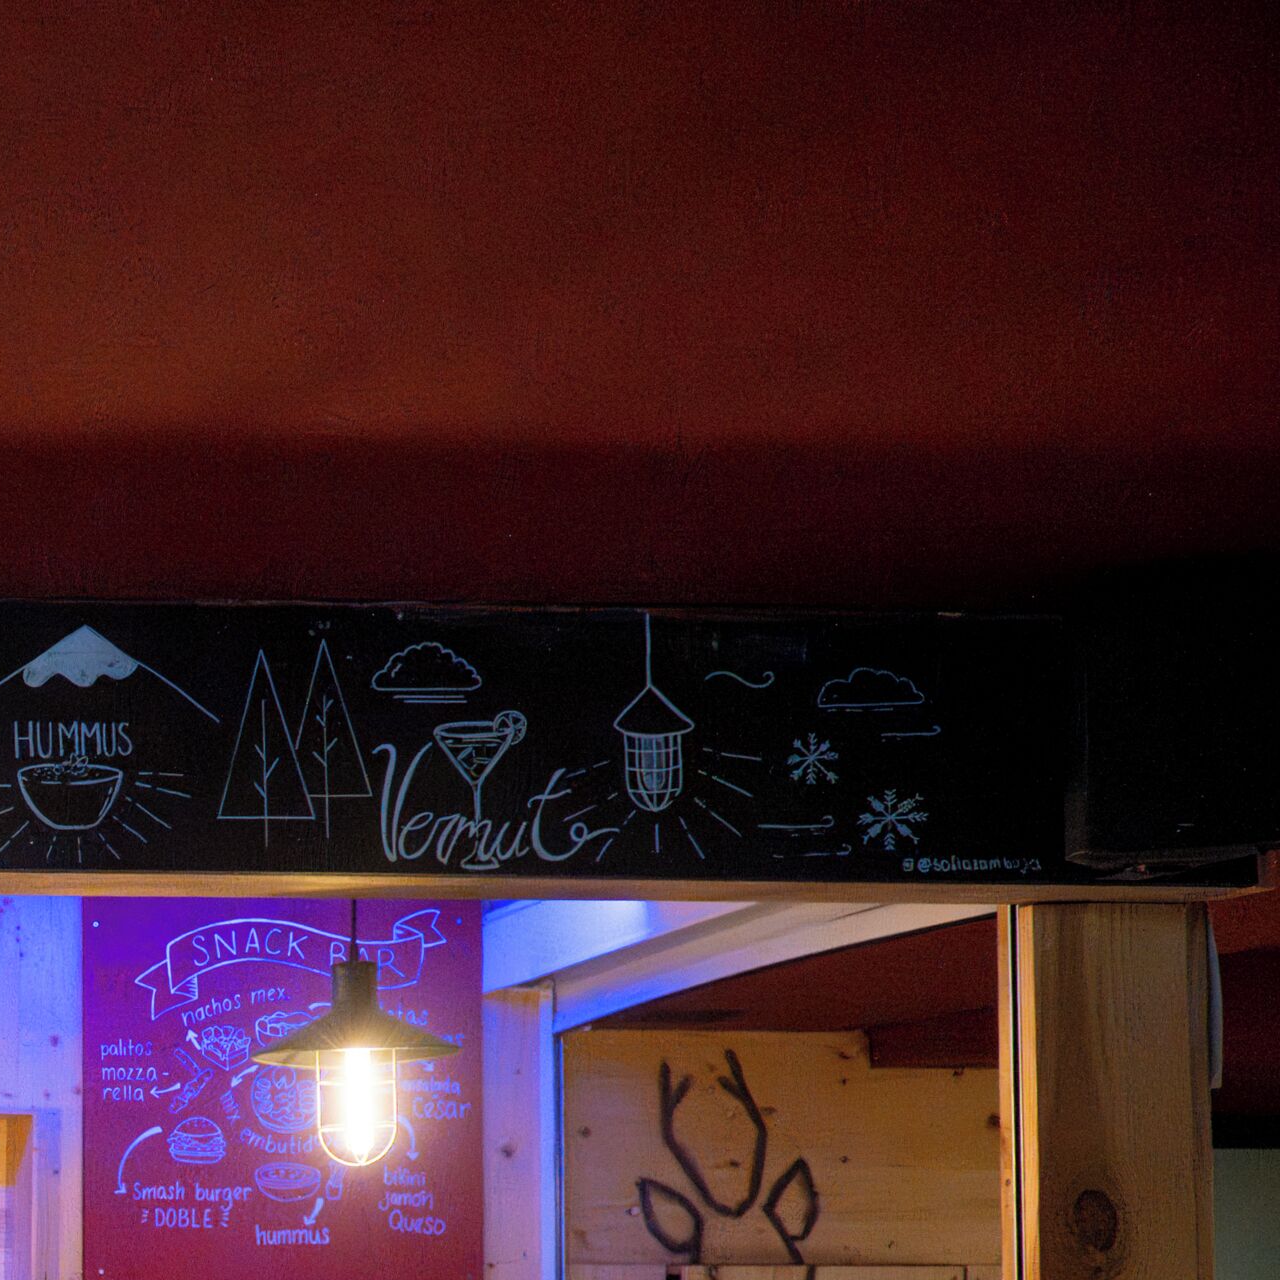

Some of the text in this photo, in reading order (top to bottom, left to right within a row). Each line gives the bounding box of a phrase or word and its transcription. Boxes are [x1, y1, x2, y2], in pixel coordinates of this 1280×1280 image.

[13, 720, 133, 760] HUMMUS
[371, 742, 621, 864] Vermut
[191, 927, 309, 967] SNACK
[181, 993, 241, 1027] nachos
[100, 1038, 153, 1061] palitos
[102, 1084, 145, 1102] rella
[383, 1164, 427, 1187] bikini
[194, 1182, 253, 1211] burger
[377, 1189, 434, 1211] jamón
[154, 1207, 214, 1229] DOBLE
[255, 1225, 330, 1246] hummus
